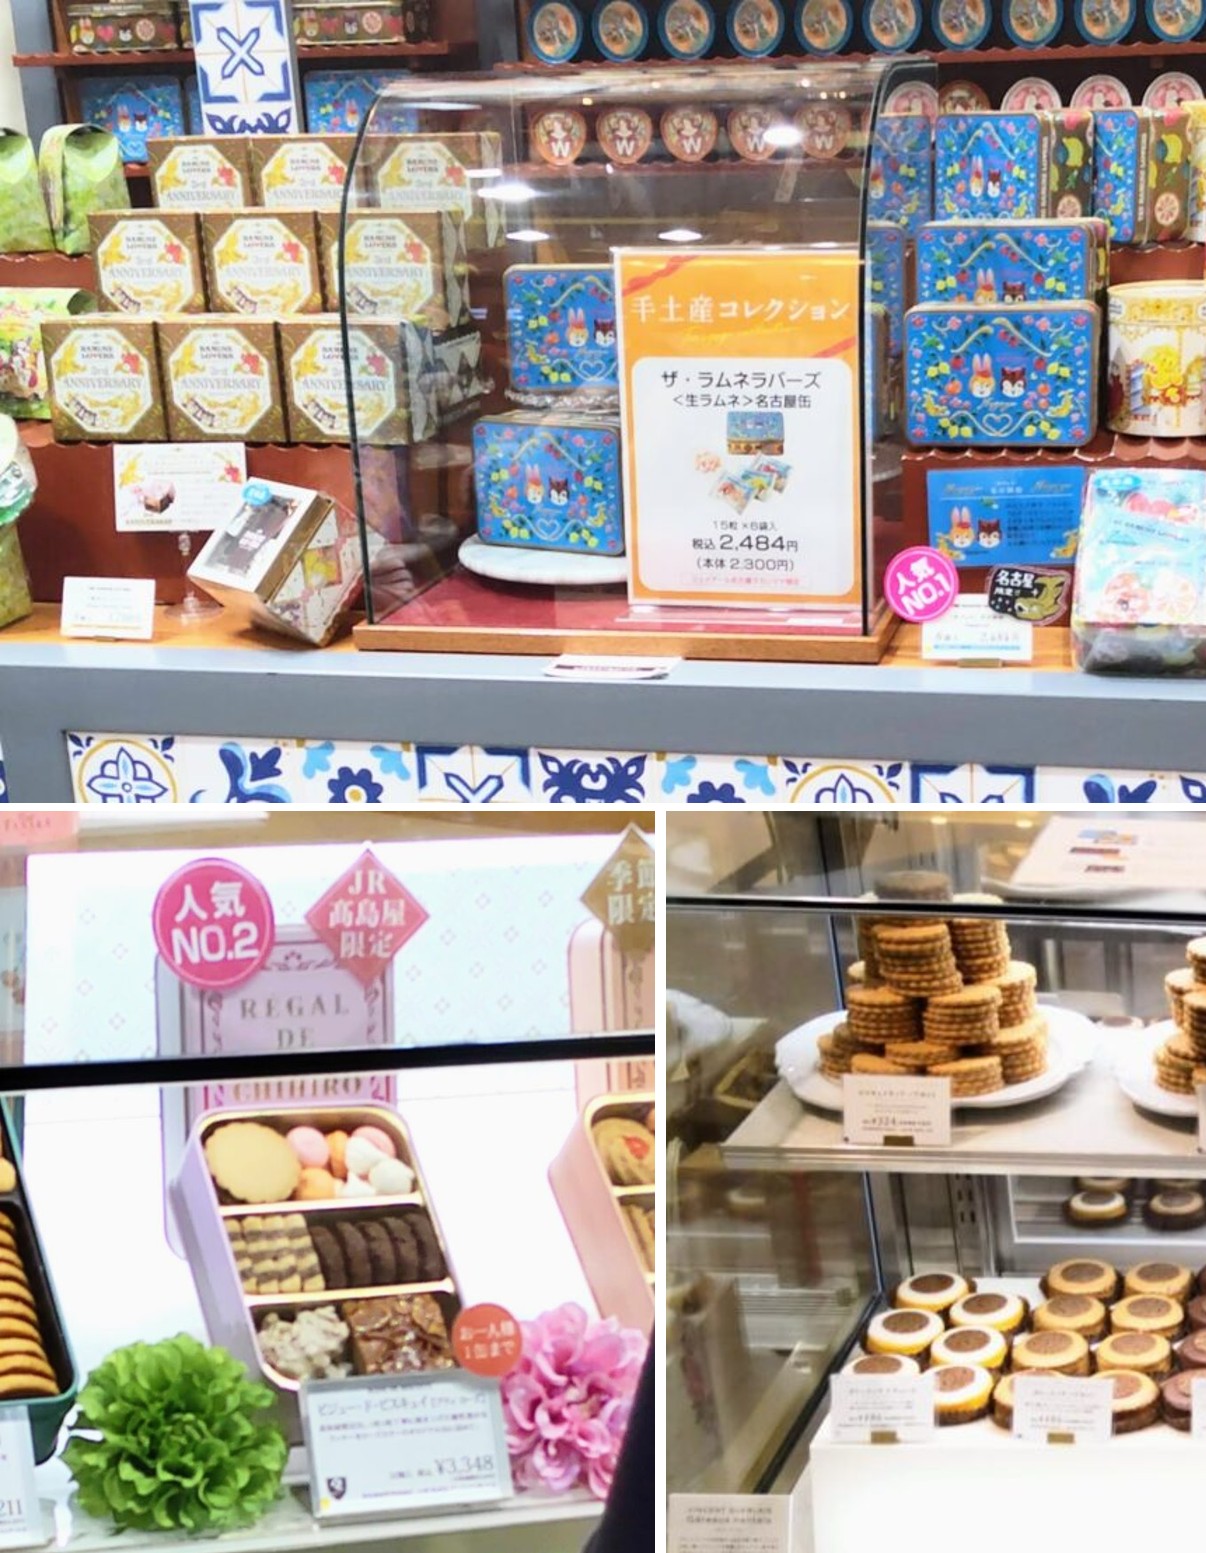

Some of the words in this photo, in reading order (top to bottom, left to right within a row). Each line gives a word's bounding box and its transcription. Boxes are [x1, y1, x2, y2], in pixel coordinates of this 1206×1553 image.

[631, 295, 850, 323] 手土産コレクション
[661, 371, 822, 389] ザ・ラムネラバーズ
[896, 555, 935, 595] 人気
[901, 572, 951, 616] NO.1
[348, 869, 388, 895] JR
[174, 881, 246, 922] 人気
[171, 921, 260, 965] NO.2
[339, 929, 394, 959] 限定
[277, 1027, 315, 1050] DE
